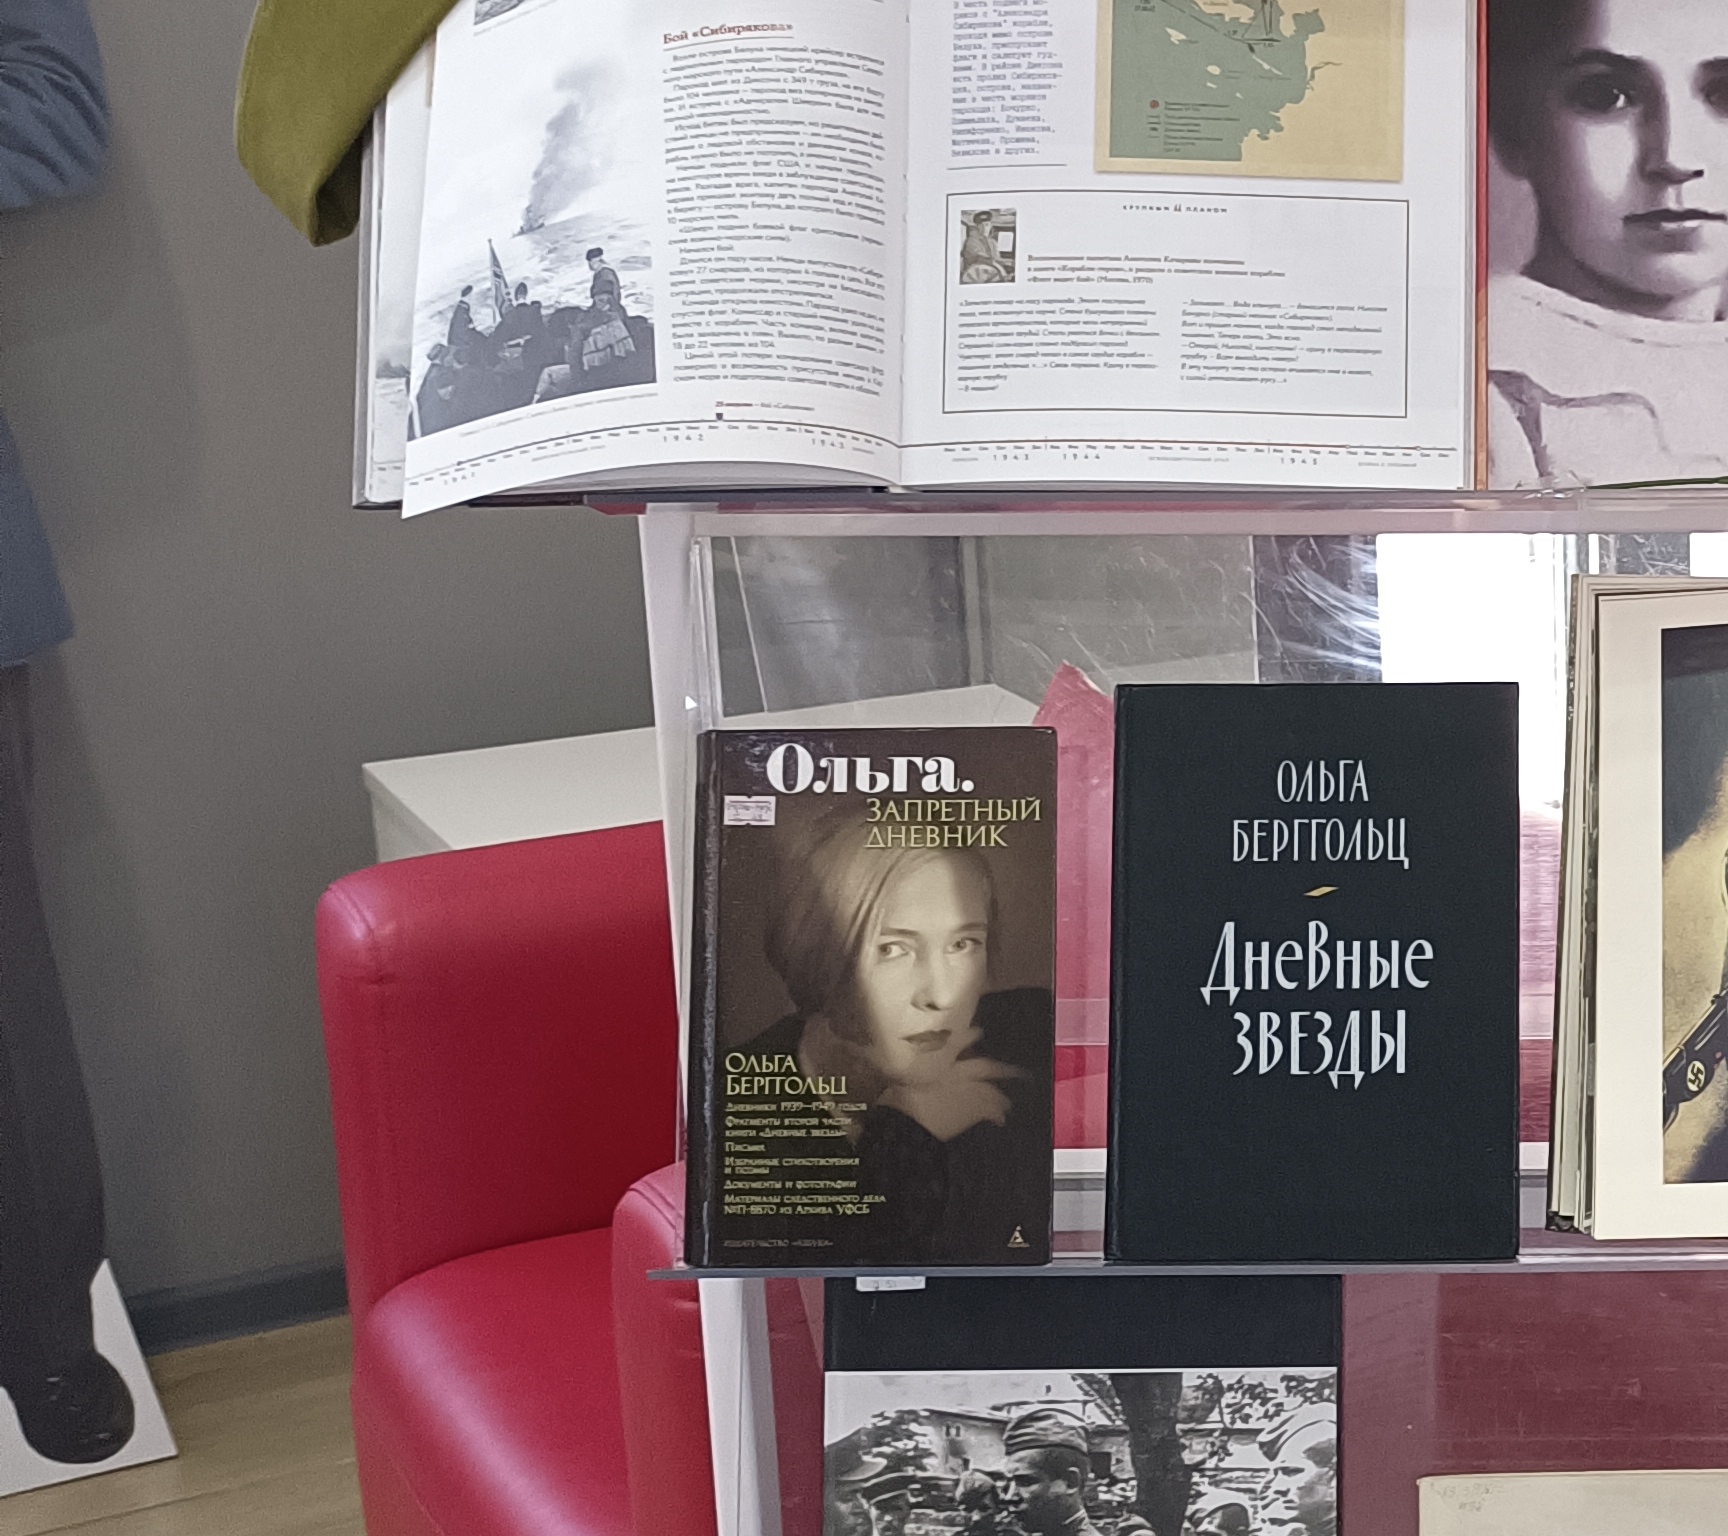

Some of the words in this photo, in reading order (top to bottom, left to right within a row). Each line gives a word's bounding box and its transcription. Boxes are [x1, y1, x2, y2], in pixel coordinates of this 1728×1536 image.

[766, 741, 976, 795] Ольга.
[1277, 759, 1370, 803] ОЛЬГА
[866, 796, 1042, 824] ЗАПРЕТНЫЙ
[865, 824, 1008, 849] ДНЕВНИК
[1232, 817, 1410, 870] БЕРГГОЛЬЦ
[725, 1052, 798, 1073] ОЛЬГА
[1232, 1010, 1407, 1090] ЗВЕЗДЫ
